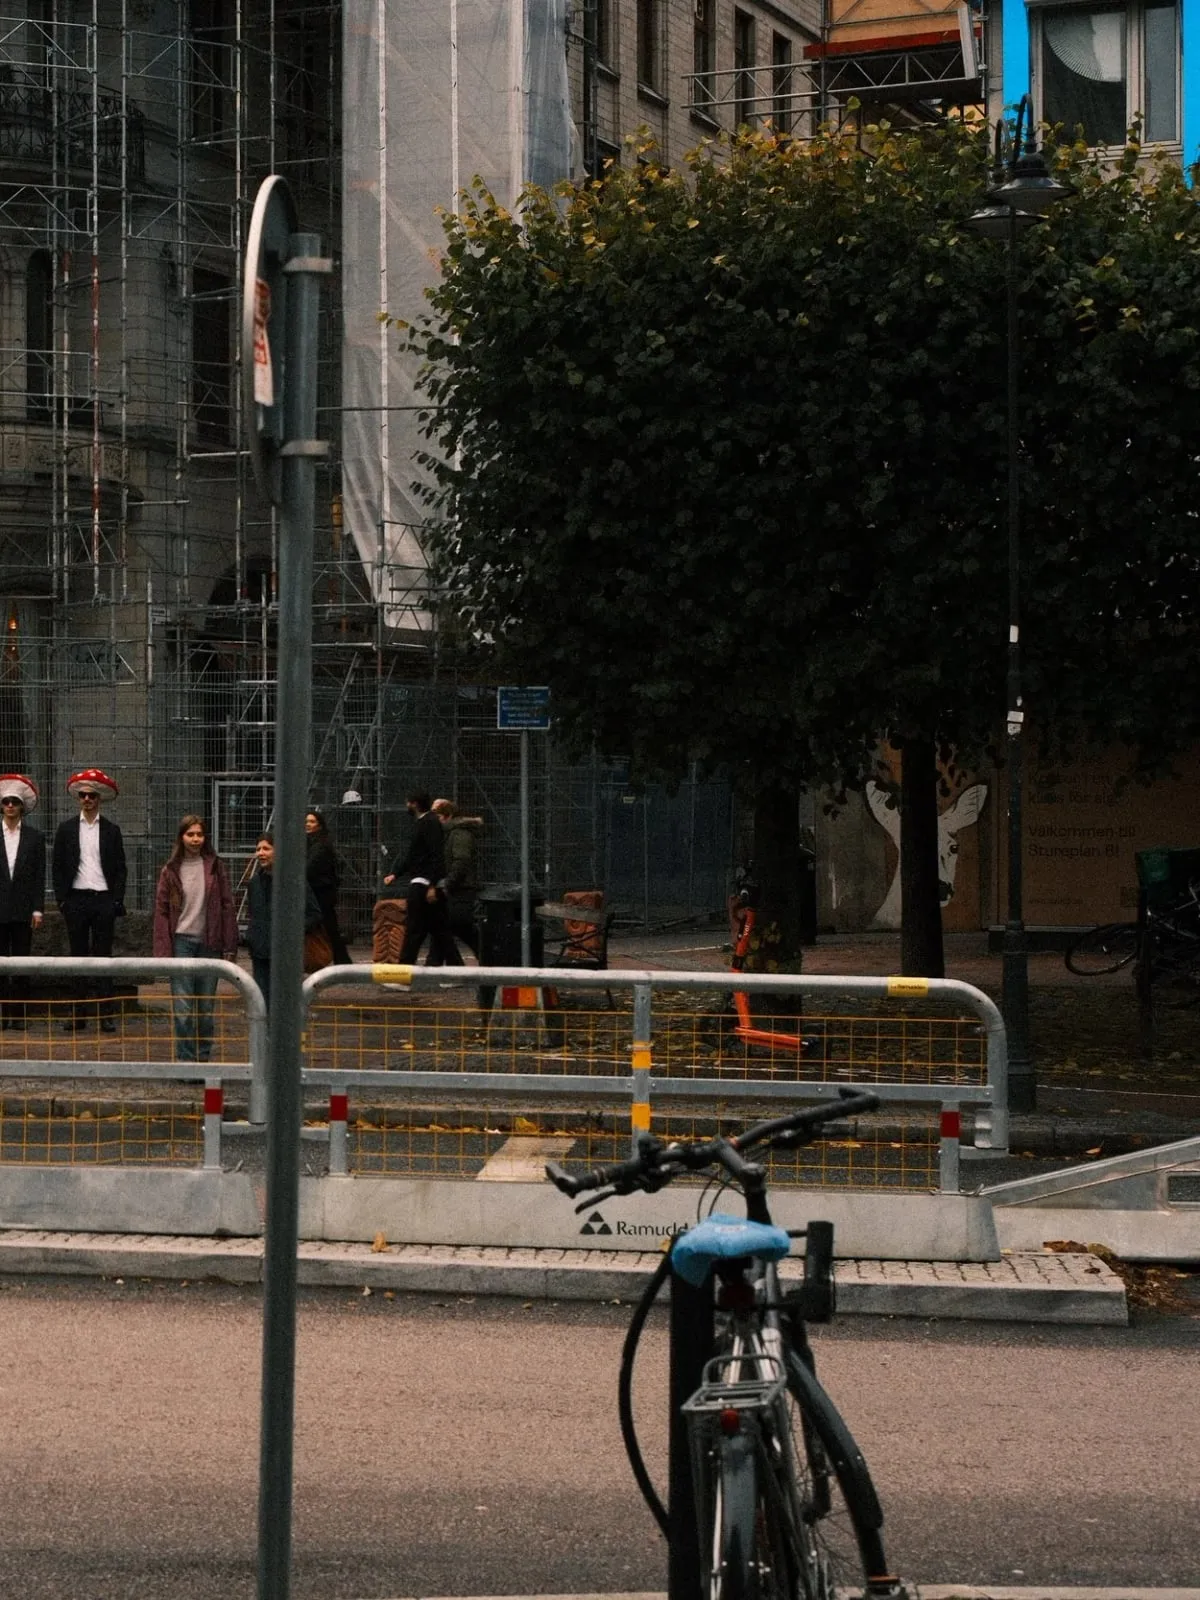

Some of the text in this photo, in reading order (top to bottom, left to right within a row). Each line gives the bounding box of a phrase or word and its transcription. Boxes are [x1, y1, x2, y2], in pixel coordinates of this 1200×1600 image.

[1028, 824, 1136, 838] Välkommen till
[1028, 843, 1101, 859] Stureplan
